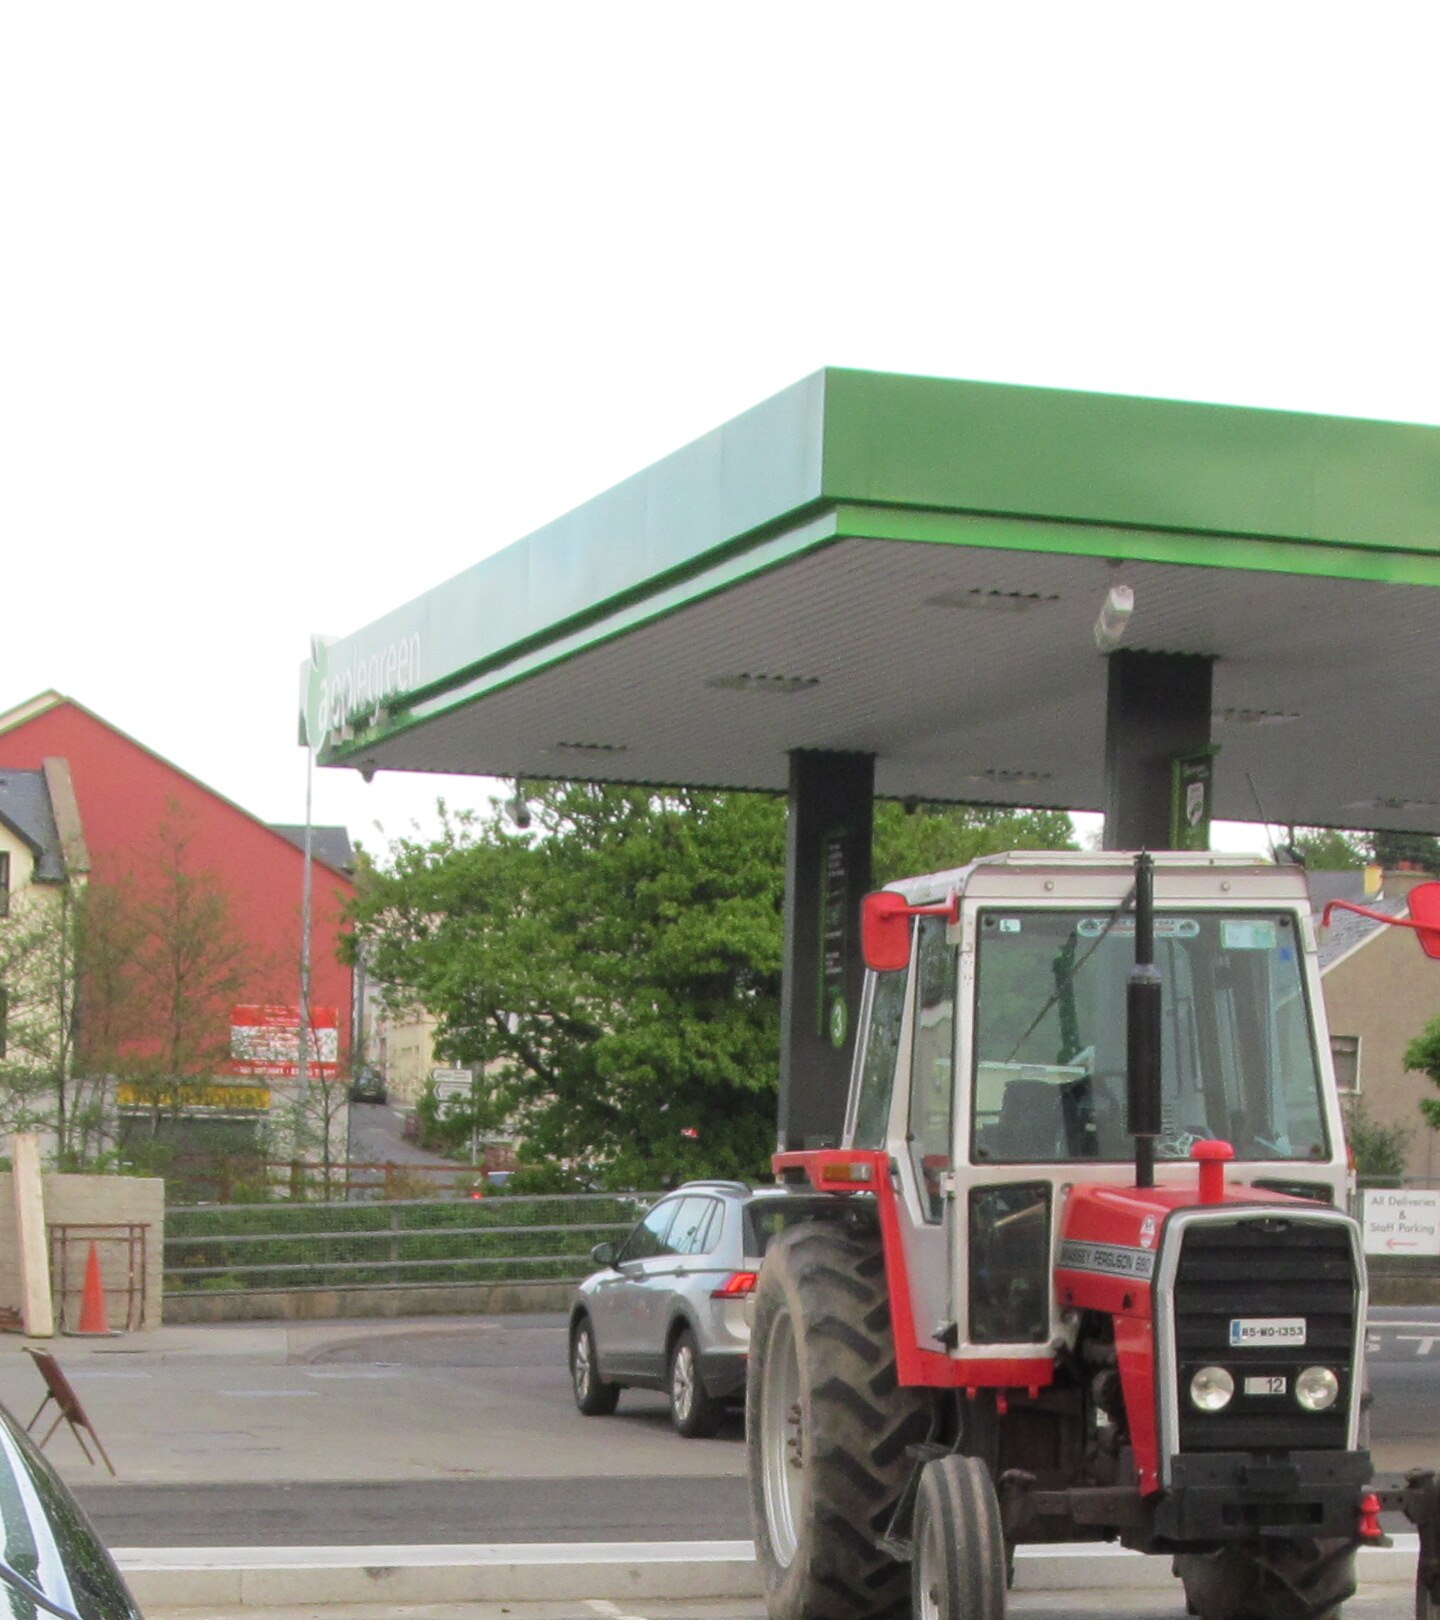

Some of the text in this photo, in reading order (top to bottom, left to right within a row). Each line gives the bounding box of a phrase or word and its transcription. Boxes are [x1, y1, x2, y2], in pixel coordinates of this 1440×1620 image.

[1370, 1195, 1436, 1207] All Deliveries
[1398, 1210, 1407, 1221] &
[1370, 1222, 1436, 1235] Staff Parking
